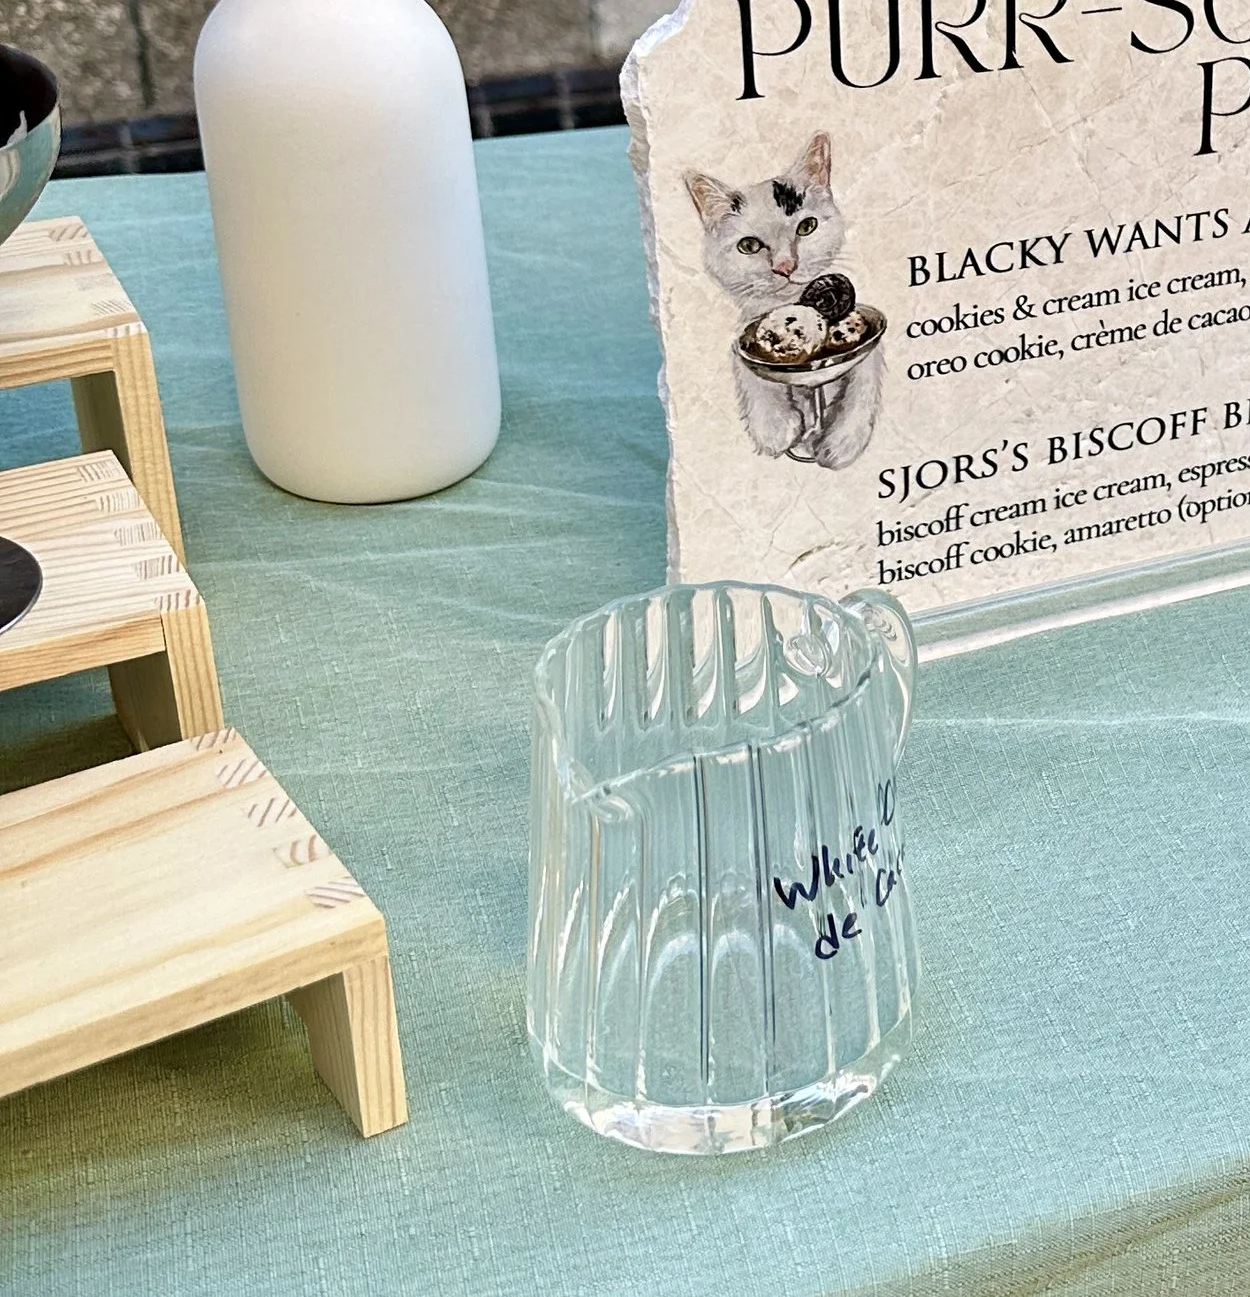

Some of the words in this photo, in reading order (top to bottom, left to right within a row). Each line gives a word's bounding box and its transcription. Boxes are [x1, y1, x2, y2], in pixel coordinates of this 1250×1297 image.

[908, 233, 1072, 287] BLACKY
[1084, 208, 1228, 258] WANTS
[906, 303, 1005, 338] cookies
[1013, 295, 1037, 320] &
[1043, 289, 1121, 315] cream
[1127, 279, 1161, 301] ice
[1167, 268, 1246, 294] cream,
[907, 356, 967, 380] oreo
[974, 334, 1064, 368] cookie,
[1071, 320, 1146, 351] crème
[1153, 309, 1182, 336] de
[878, 440, 1028, 507] SJORS'S
[1048, 407, 1207, 465] BISCOFF
[876, 503, 969, 547] biscoff
[970, 499, 1047, 527] cream
[1054, 488, 1087, 510] ice
[1093, 474, 1171, 501] cream,
[877, 542, 970, 585] biscoff
[970, 530, 1057, 564] cookie,
[1064, 509, 1171, 544] amaretto
[773, 825, 879, 910] White
[815, 912, 862, 960] de
